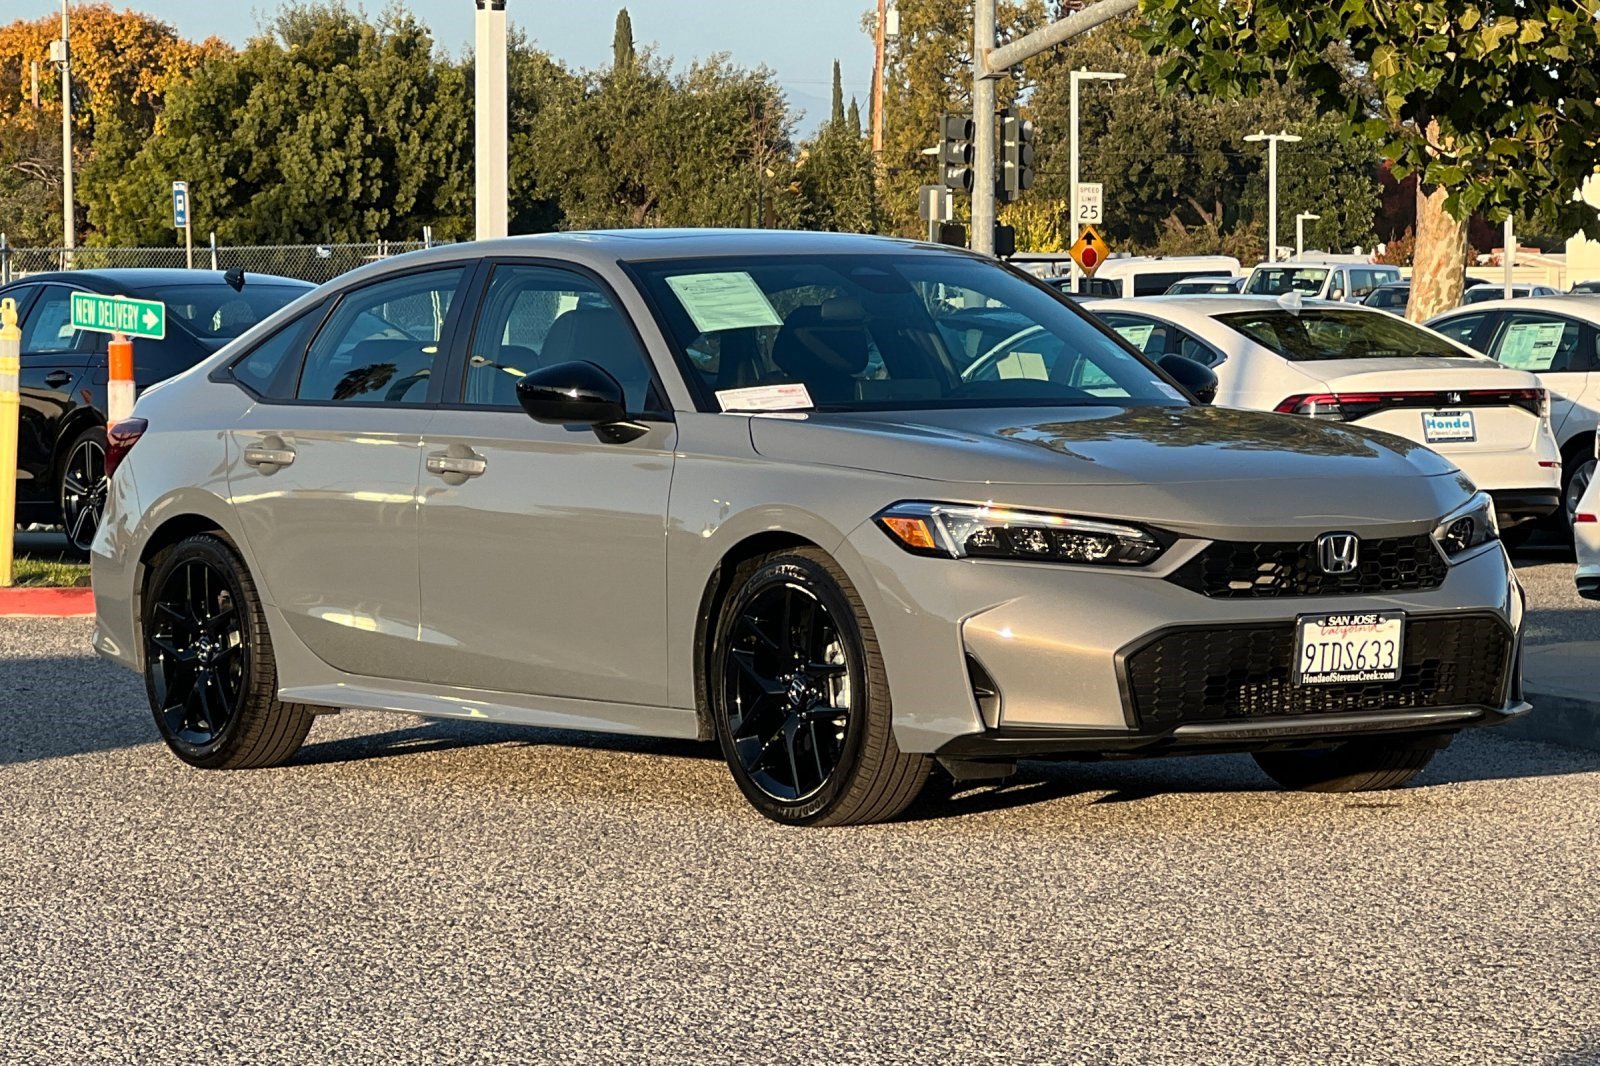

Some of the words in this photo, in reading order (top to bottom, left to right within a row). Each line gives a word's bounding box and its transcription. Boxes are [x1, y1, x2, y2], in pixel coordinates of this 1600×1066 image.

[1080, 204, 1098, 219] 25
[75, 298, 96, 325] NEW
[98, 300, 139, 330] DELIVERY
[1426, 418, 1470, 429] Honda
[1328, 616, 1350, 626] SAN
[1351, 614, 1378, 625] JOSE
[1305, 639, 1395, 674] 9TDS633
